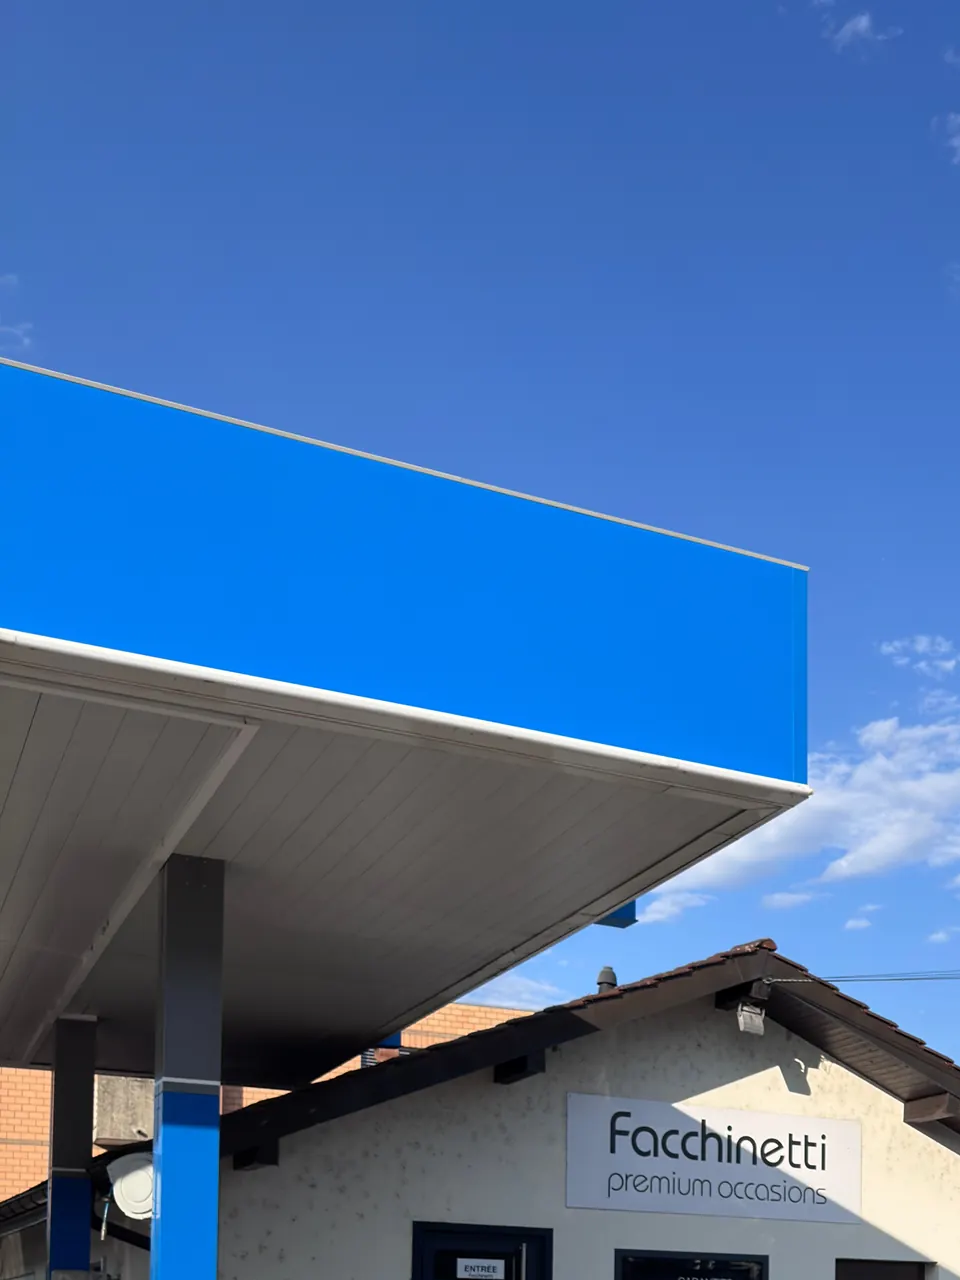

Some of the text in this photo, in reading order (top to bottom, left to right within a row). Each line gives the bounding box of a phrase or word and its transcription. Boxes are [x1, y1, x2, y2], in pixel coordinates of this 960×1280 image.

[609, 1111, 827, 1171] Facchinetti
[607, 1171, 828, 1205] premium occasions
[464, 1264, 498, 1273] ENTRÉE
